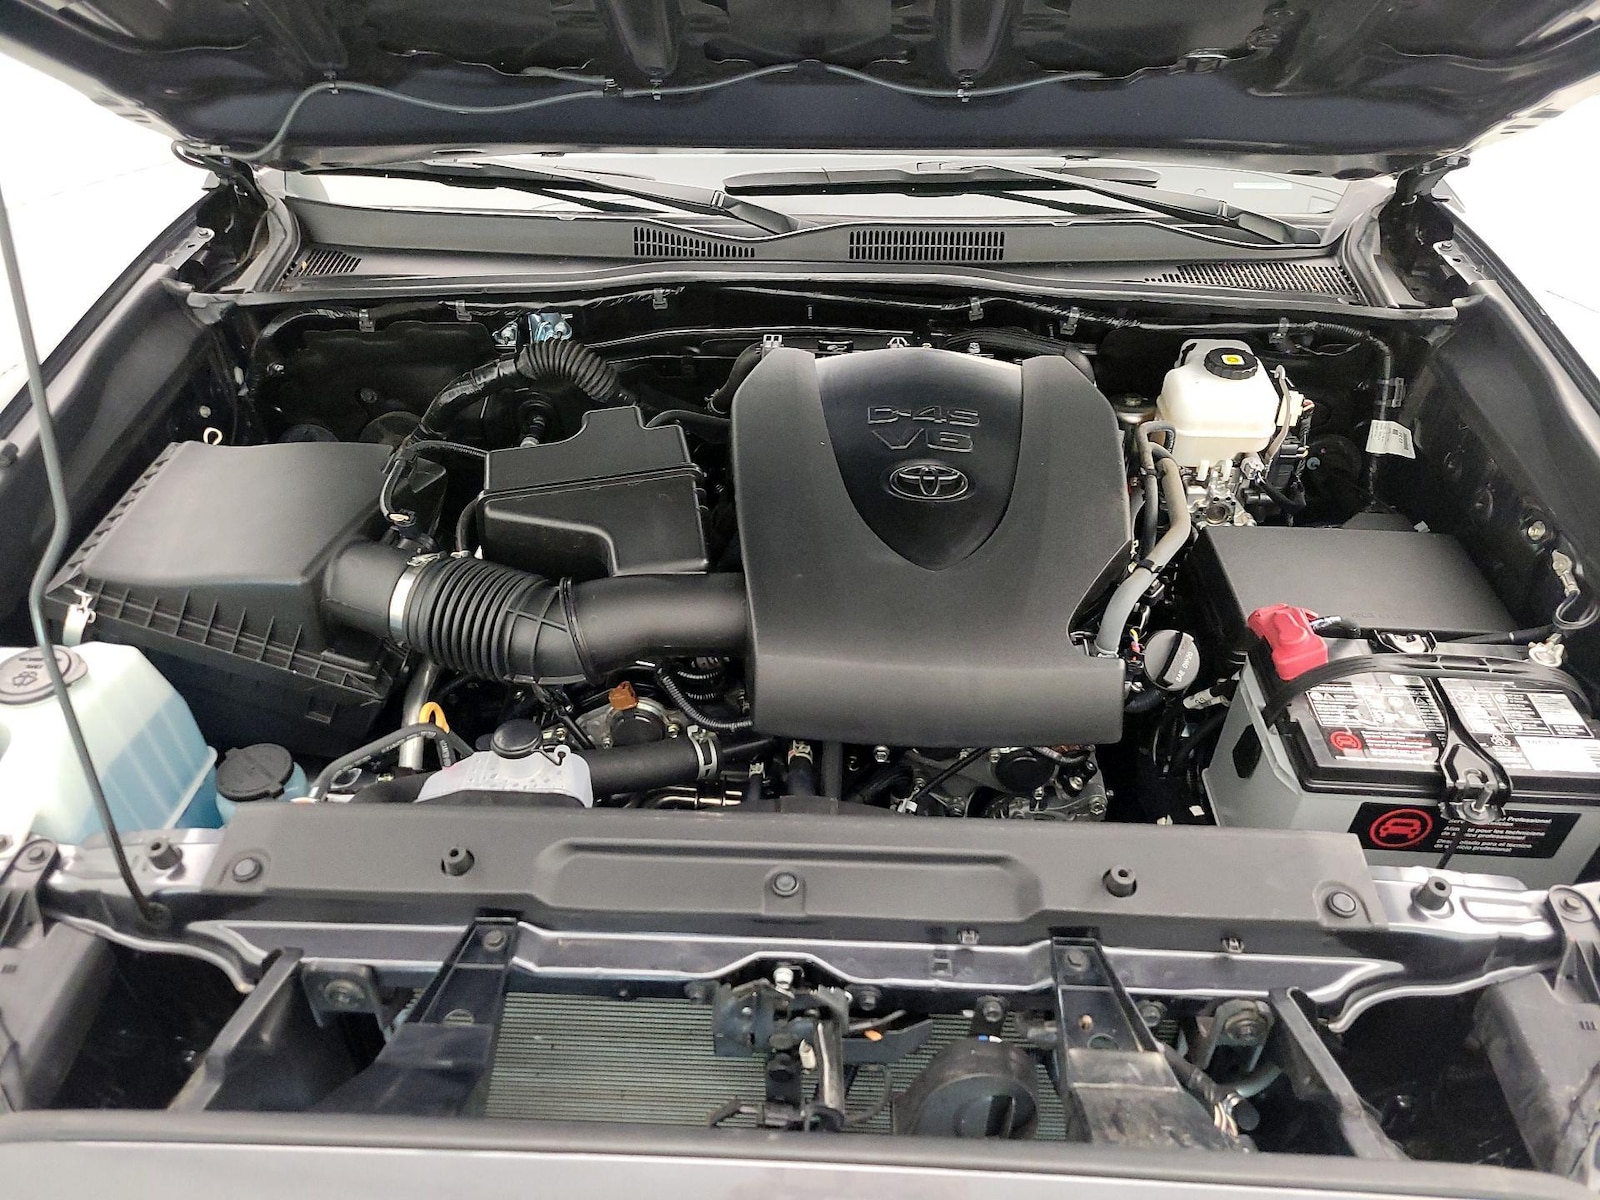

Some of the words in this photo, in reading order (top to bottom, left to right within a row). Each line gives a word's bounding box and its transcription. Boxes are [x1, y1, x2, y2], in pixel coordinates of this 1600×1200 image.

[868, 405, 980, 427] D-4S
[871, 427, 974, 453] V6
[1507, 816, 1552, 824] Professional
